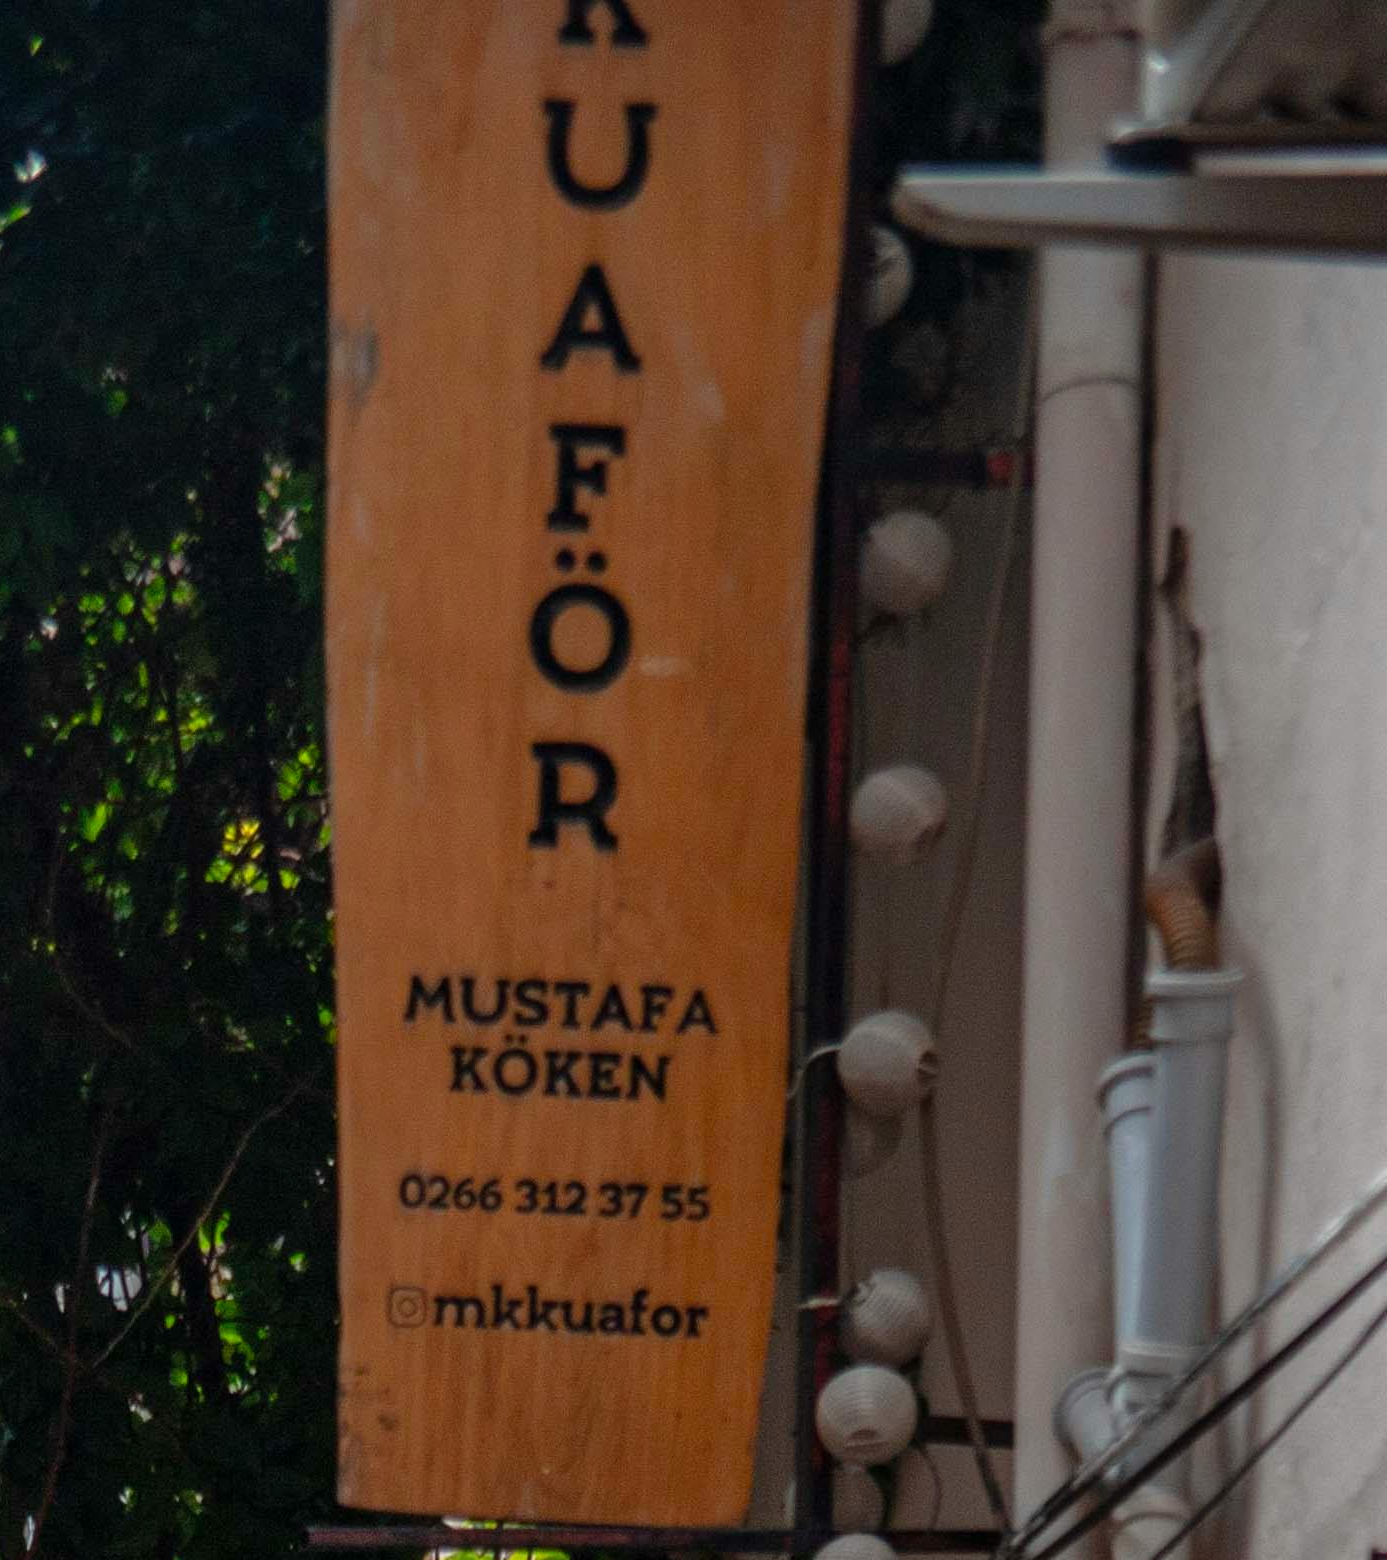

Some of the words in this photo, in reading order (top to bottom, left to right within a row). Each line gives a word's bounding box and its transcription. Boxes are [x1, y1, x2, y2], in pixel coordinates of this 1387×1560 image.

[403, 975, 718, 1035] MUSTAFA
[450, 1034, 671, 1101] KÖKEN
[399, 1173, 503, 1213] 0266
[516, 1178, 588, 1216] 312
[599, 1182, 649, 1218] 37
[660, 1184, 711, 1221] 55
[433, 1285, 710, 1338] mkkuafor
